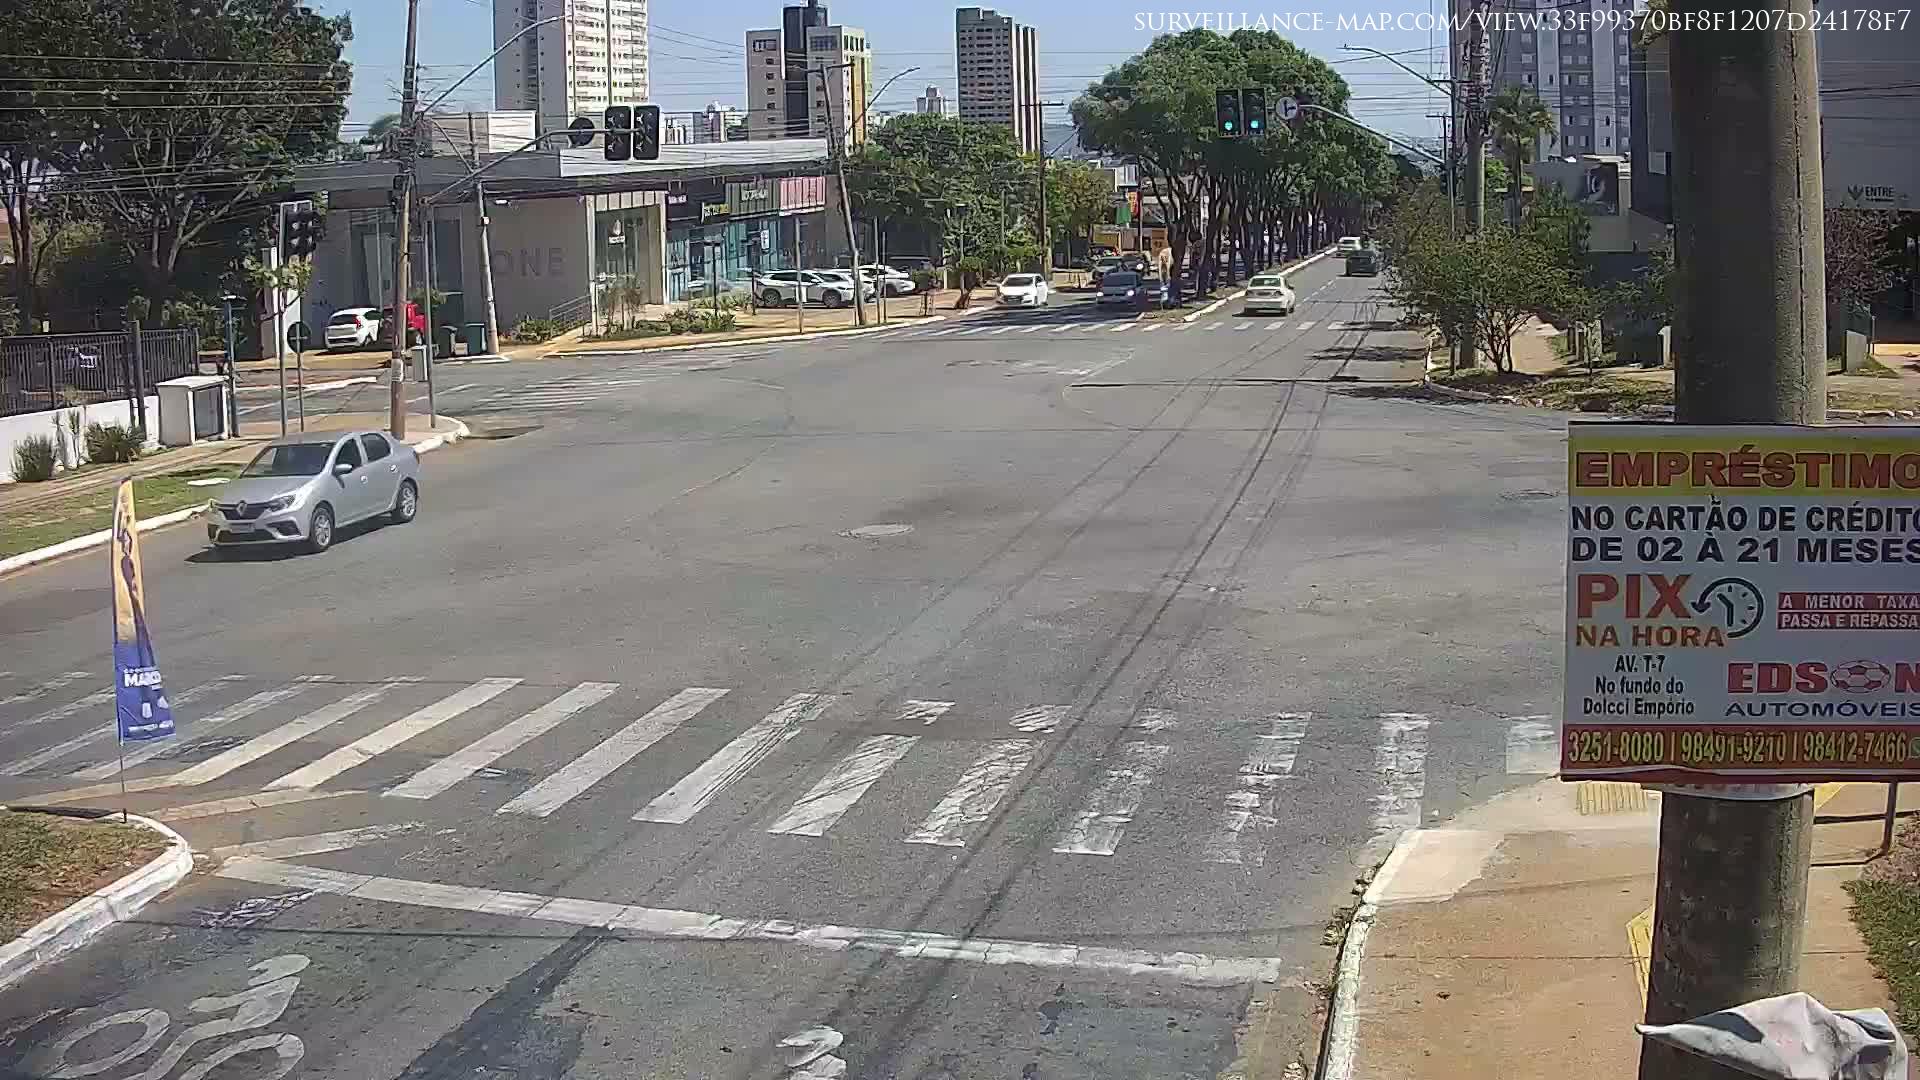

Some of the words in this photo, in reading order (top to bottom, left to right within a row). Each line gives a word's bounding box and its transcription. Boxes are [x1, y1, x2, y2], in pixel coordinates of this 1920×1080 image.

[1865, 186, 1895, 197] ENTRE
[1572, 506, 1614, 531] NO
[1624, 498, 1748, 531] CARTÃO
[1758, 506, 1796, 531] DE
[1572, 536, 1622, 562] DE
[1636, 537, 1684, 562] 02
[1737, 537, 1779, 563] 21
[1797, 537, 1920, 563] MESES
[1577, 573, 1692, 619] PIX
[1781, 595, 1793, 609] A
[1805, 595, 1865, 609] MENOR
[1877, 595, 1920, 609] TAXA
[1781, 613, 1831, 628] PASSA
[1836, 613, 1846, 628] E
[1850, 613, 1918, 628] REPASSA
[1576, 625, 1620, 647] NA
[1632, 625, 1725, 647] HORA
[1615, 654, 1638, 673] AV.
[1643, 654, 1665, 673] T-7
[1595, 676, 1616, 694] No
[1620, 676, 1660, 694] fundo
[1665, 676, 1684, 694] do
[1583, 697, 1629, 715] Dolcci
[1634, 697, 1695, 719] Empório
[1568, 730, 1665, 763] 3251-8080
[1803, 730, 1907, 763] 98412-7466
